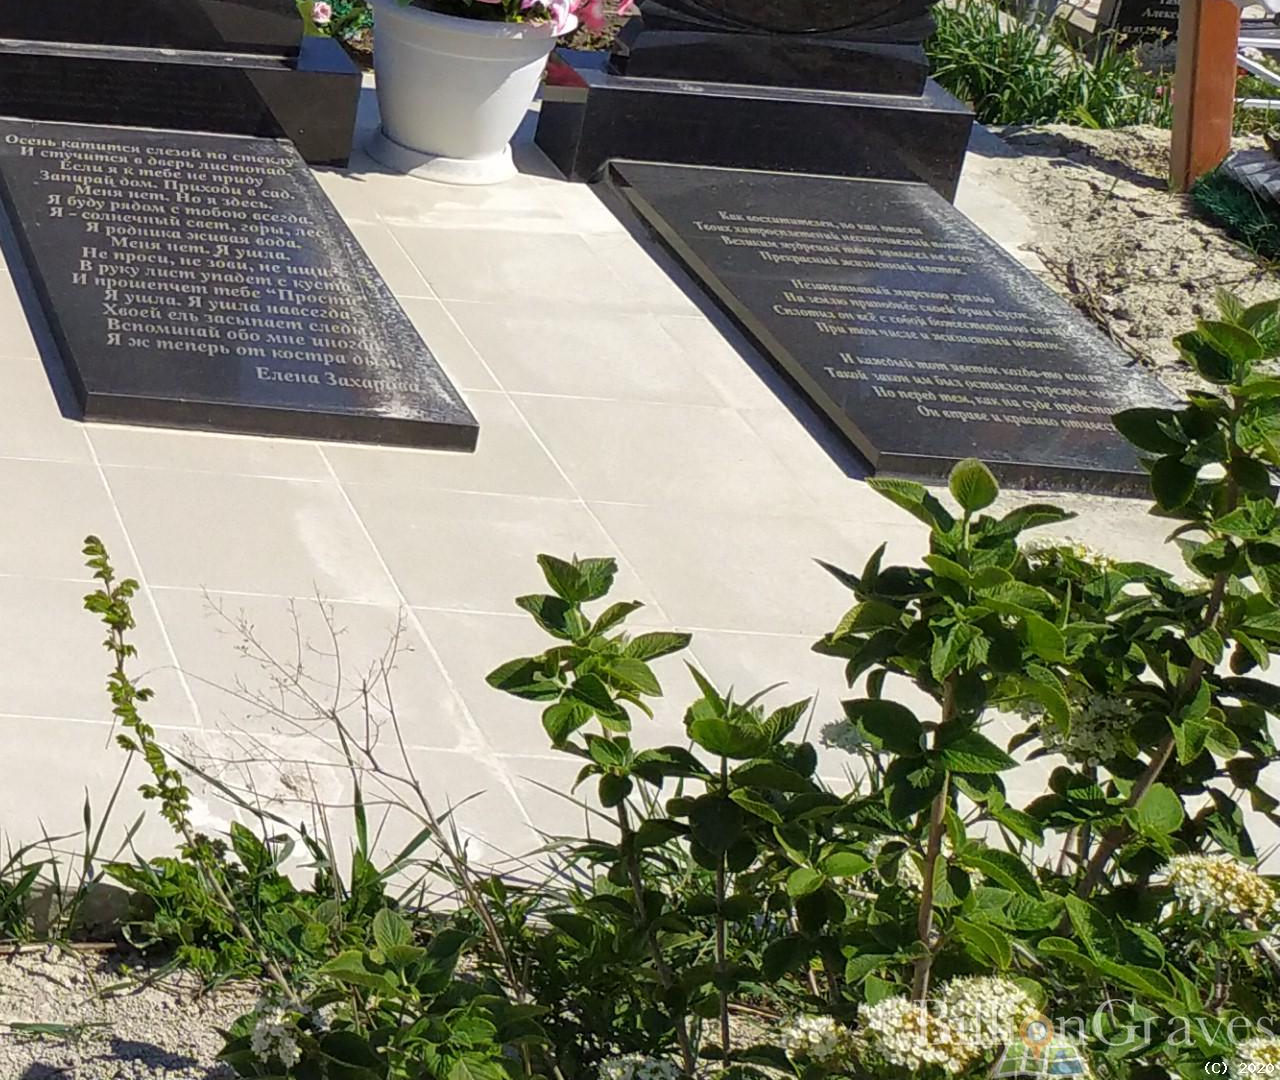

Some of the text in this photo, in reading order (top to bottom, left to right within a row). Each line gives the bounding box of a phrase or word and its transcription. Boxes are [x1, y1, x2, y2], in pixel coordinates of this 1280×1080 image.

[5, 134, 56, 148] Осень
[60, 139, 139, 155] катится
[146, 145, 200, 159] слезой
[206, 151, 226, 160] по
[20, 146, 33, 156] И
[40, 148, 127, 165] стучится
[147, 156, 193, 171] дверь
[40, 169, 113, 187] Запирай
[119, 176, 157, 189] дом.
[164, 179, 241, 197] Приходи
[261, 188, 294, 200] сад.
[60, 159, 101, 173] Если
[139, 166, 180, 179] тебе
[187, 171, 206, 181] не
[212, 172, 262, 187] приду
[47, 193, 60, 205] Я
[67, 195, 104, 210] буду
[110, 199, 164, 215] рядом
[185, 204, 246, 220] тобою
[74, 184, 122, 198] Меня
[176, 192, 200, 203] Но
[49, 206, 62, 217] Я
[81, 208, 180, 228] солнечный
[86, 221, 98, 232] Я
[105, 222, 180, 242] родника
[81, 246, 107, 259] Не
[180, 255, 201, 266] не
[260, 263, 280, 273] не
[110, 235, 161, 250] Меня
[213, 243, 228, 258] Я
[80, 259, 92, 272] В
[98, 262, 139, 278] руку
[144, 266, 195, 280] лист
[71, 272, 260, 299] И прошепчет тебе
[103, 288, 117, 301] Я
[187, 295, 201, 307] Я
[208, 299, 260, 315] ушла
[103, 302, 302, 331] Хвоей ель засыпает
[107, 316, 305, 345] Вспоминай обо мне
[106, 332, 120, 345] Я
[156, 337, 229, 357] теперь
[236, 344, 265, 356] от
[272, 347, 346, 367] костра
[255, 365, 320, 385] Елена
